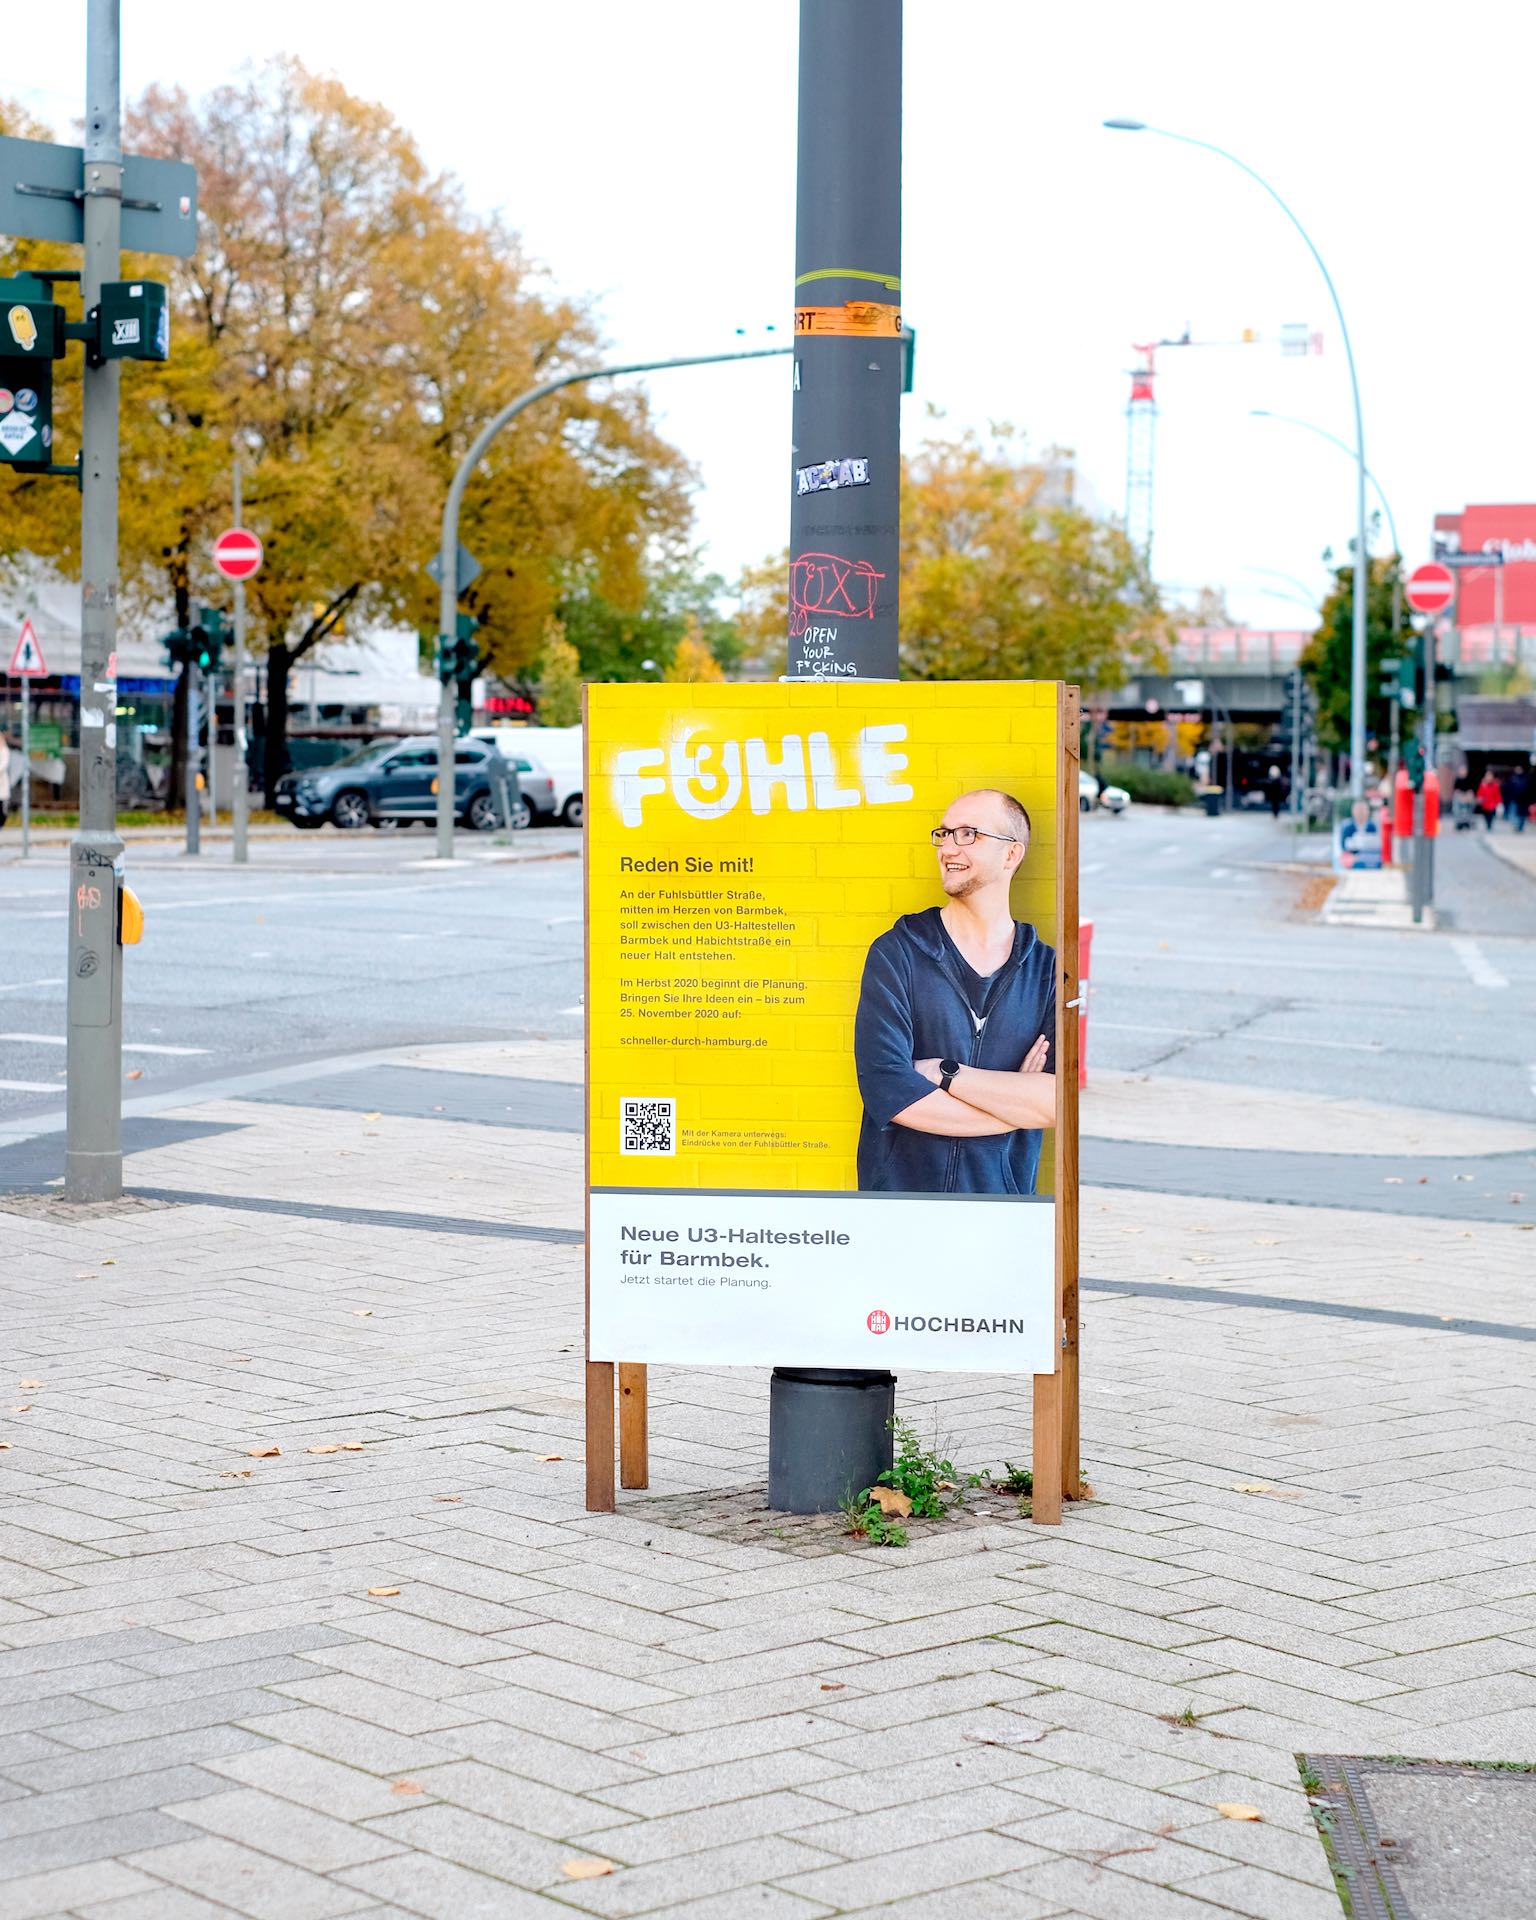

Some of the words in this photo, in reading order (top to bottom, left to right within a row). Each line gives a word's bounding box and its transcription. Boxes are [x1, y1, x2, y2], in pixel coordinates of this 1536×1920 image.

[804, 627, 838, 645] OPEN
[802, 646, 835, 659] YOUR
[620, 856, 679, 873] Reden
[684, 856, 714, 873] Sie
[719, 856, 754, 873] mit!
[619, 889, 635, 899] An
[637, 889, 656, 900] der
[658, 889, 724, 900] Fuhlsbüttler
[726, 890, 766, 901] Straße,
[620, 904, 654, 915] mitten
[656, 905, 670, 915] im
[673, 905, 711, 915] Herzen
[713, 907, 733, 915] von
[735, 905, 787, 917] Barmbek,
[619, 920, 639, 930] soll
[641, 920, 690, 930] zwischen
[692, 920, 713, 930] den
[715, 920, 796, 931] U3-Haltestellen
[620, 935, 669, 945] Barmbek
[672, 935, 693, 945] und
[695, 935, 772, 946] Habichtstraße
[774, 936, 791, 947] ein
[620, 952, 651, 960] neuer
[654, 950, 676, 960] Halt
[678, 951, 736, 961] entstehen.
[620, 977, 633, 987] Im
[636, 977, 672, 988] Herbst
[673, 978, 699, 988] 2020
[701, 978, 741, 991] beginnt
[743, 978, 760, 989] die
[762, 979, 808, 992] Planung.
[620, 992, 661, 1005] Bringen
[663, 993, 680, 1003] Sie
[682, 993, 703, 1003] Ihre
[705, 993, 735, 1004] Ideen
[737, 994, 753, 1004] ein
[764, 994, 781, 1004] bis
[782, 996, 805, 1005] zum
[620, 1008, 635, 1018] 25.
[638, 1008, 692, 1018] November
[694, 1009, 720, 1019] 2020
[721, 1009, 742, 1019] auf:
[620, 1035, 768, 1049] schneller-durch-hamburg.de
[681, 1129, 695, 1137] Mit
[695, 1129, 710, 1137] der
[711, 1129, 742, 1138] Kamera
[681, 1138, 721, 1147] Eindrücke
[738, 1140, 752, 1148] der
[753, 1140, 801, 1148] Fuhlsbüttler
[802, 1140, 831, 1149] Straße.
[620, 1225, 680, 1243] Neue
[687, 1227, 851, 1246] U3-Haltestelle
[619, 1249, 653, 1265] für
[660, 1250, 770, 1269] Barmbek.
[620, 1274, 650, 1285] Jetzt
[654, 1275, 694, 1286] startet
[697, 1276, 716, 1287] die
[720, 1276, 772, 1290] Planung.
[895, 1316, 1024, 1334] HOCHBAHN
